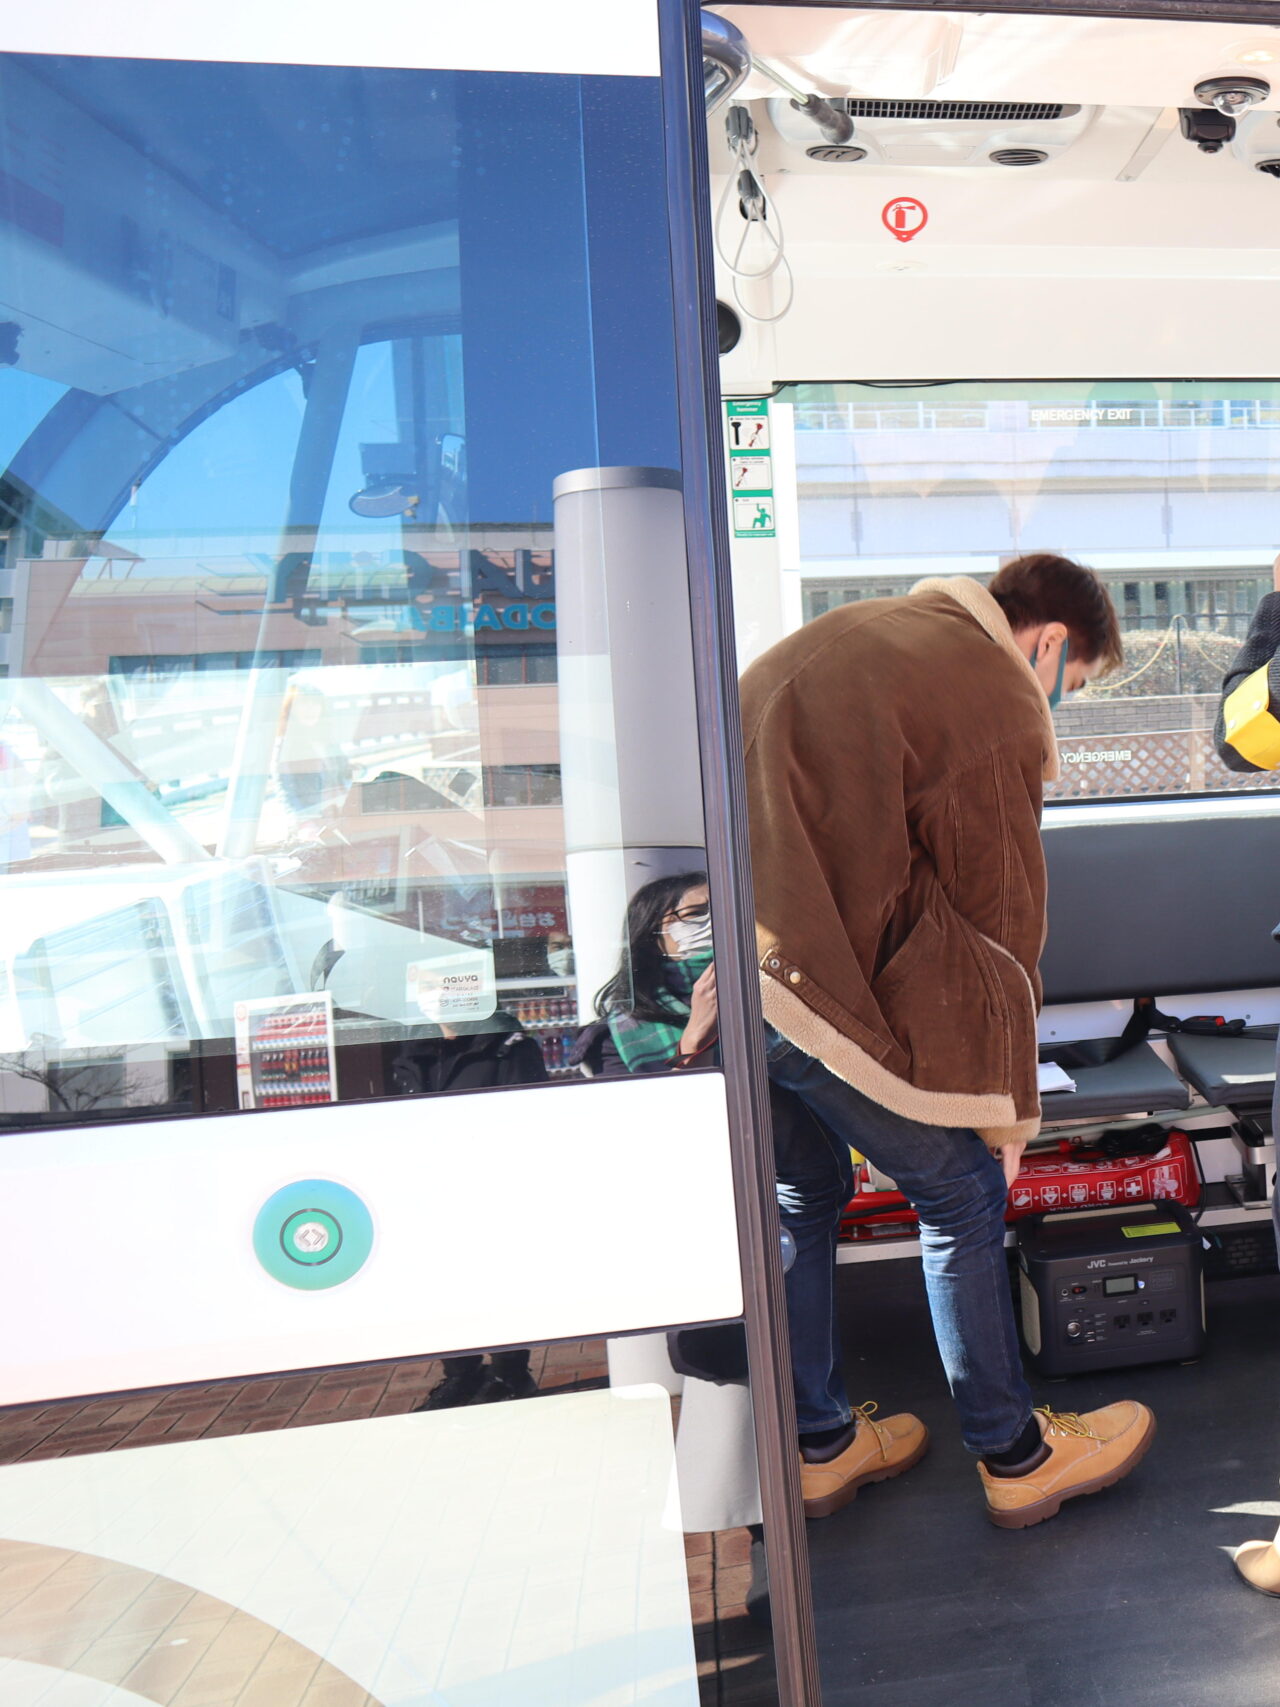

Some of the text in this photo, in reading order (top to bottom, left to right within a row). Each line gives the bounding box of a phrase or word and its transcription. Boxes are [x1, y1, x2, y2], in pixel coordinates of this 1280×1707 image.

[1031, 408, 1133, 421] EMERGENCY EXIT
[1087, 1260, 1106, 1269] JVC
